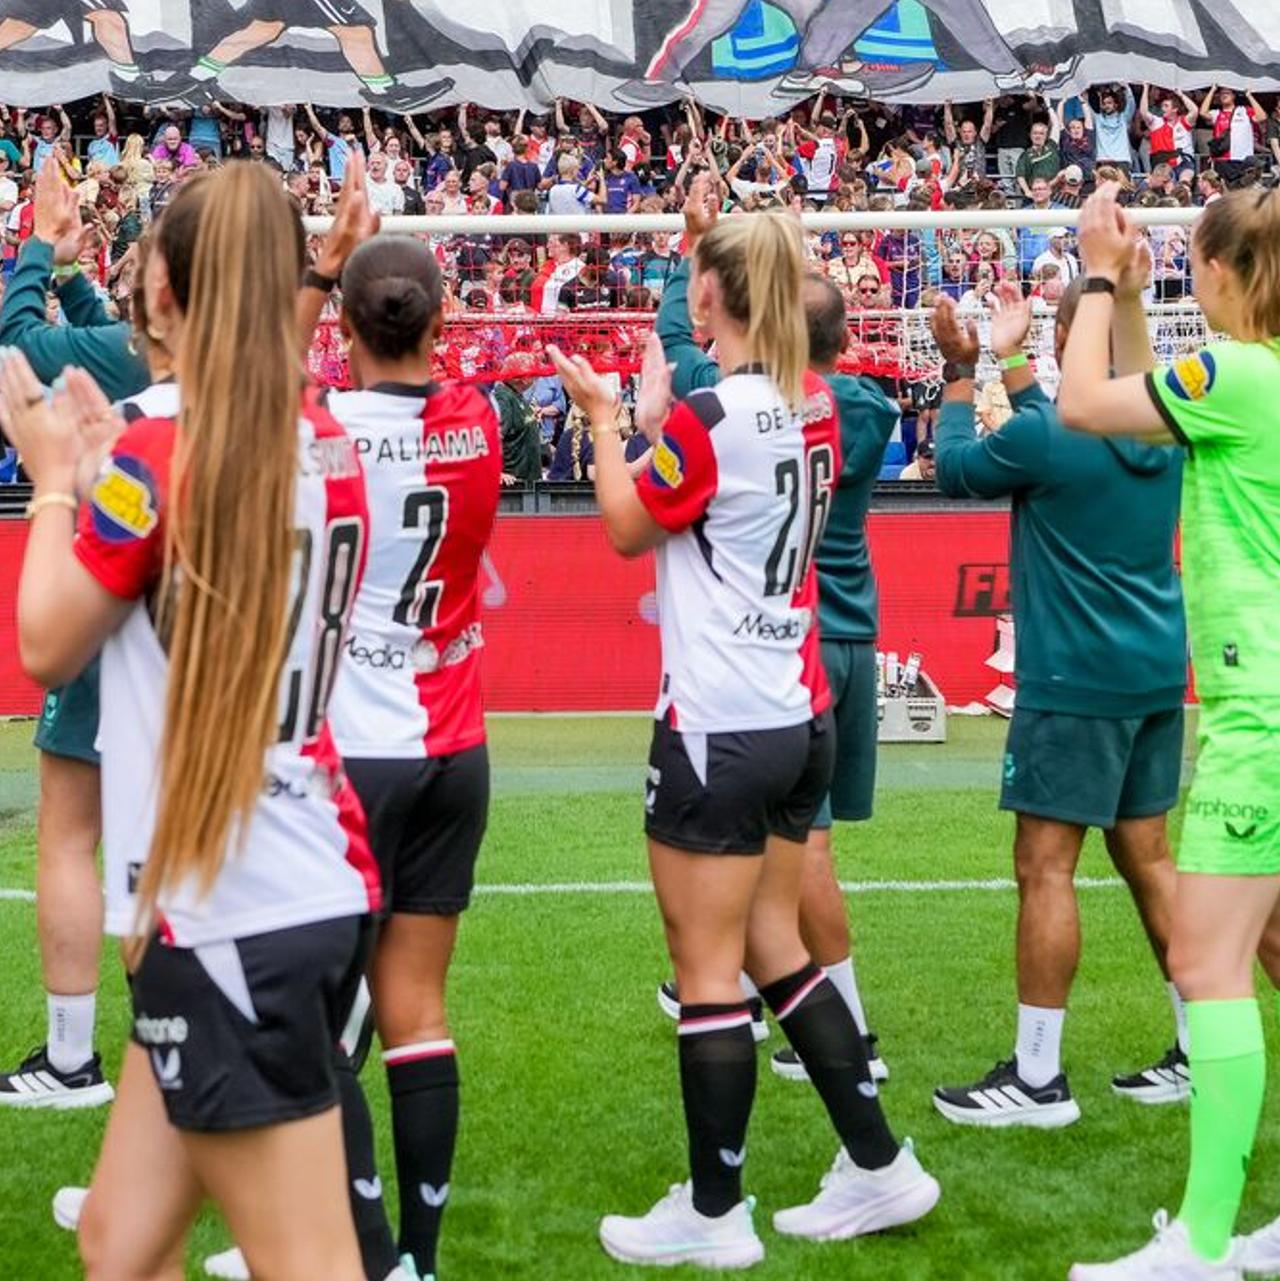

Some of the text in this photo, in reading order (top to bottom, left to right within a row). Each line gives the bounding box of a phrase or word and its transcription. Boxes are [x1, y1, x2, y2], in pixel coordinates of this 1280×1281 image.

[356, 425, 489, 466] PALIAMA
[755, 407, 785, 434] DE
[392, 485, 449, 634] 2
[763, 445, 834, 598] 26
